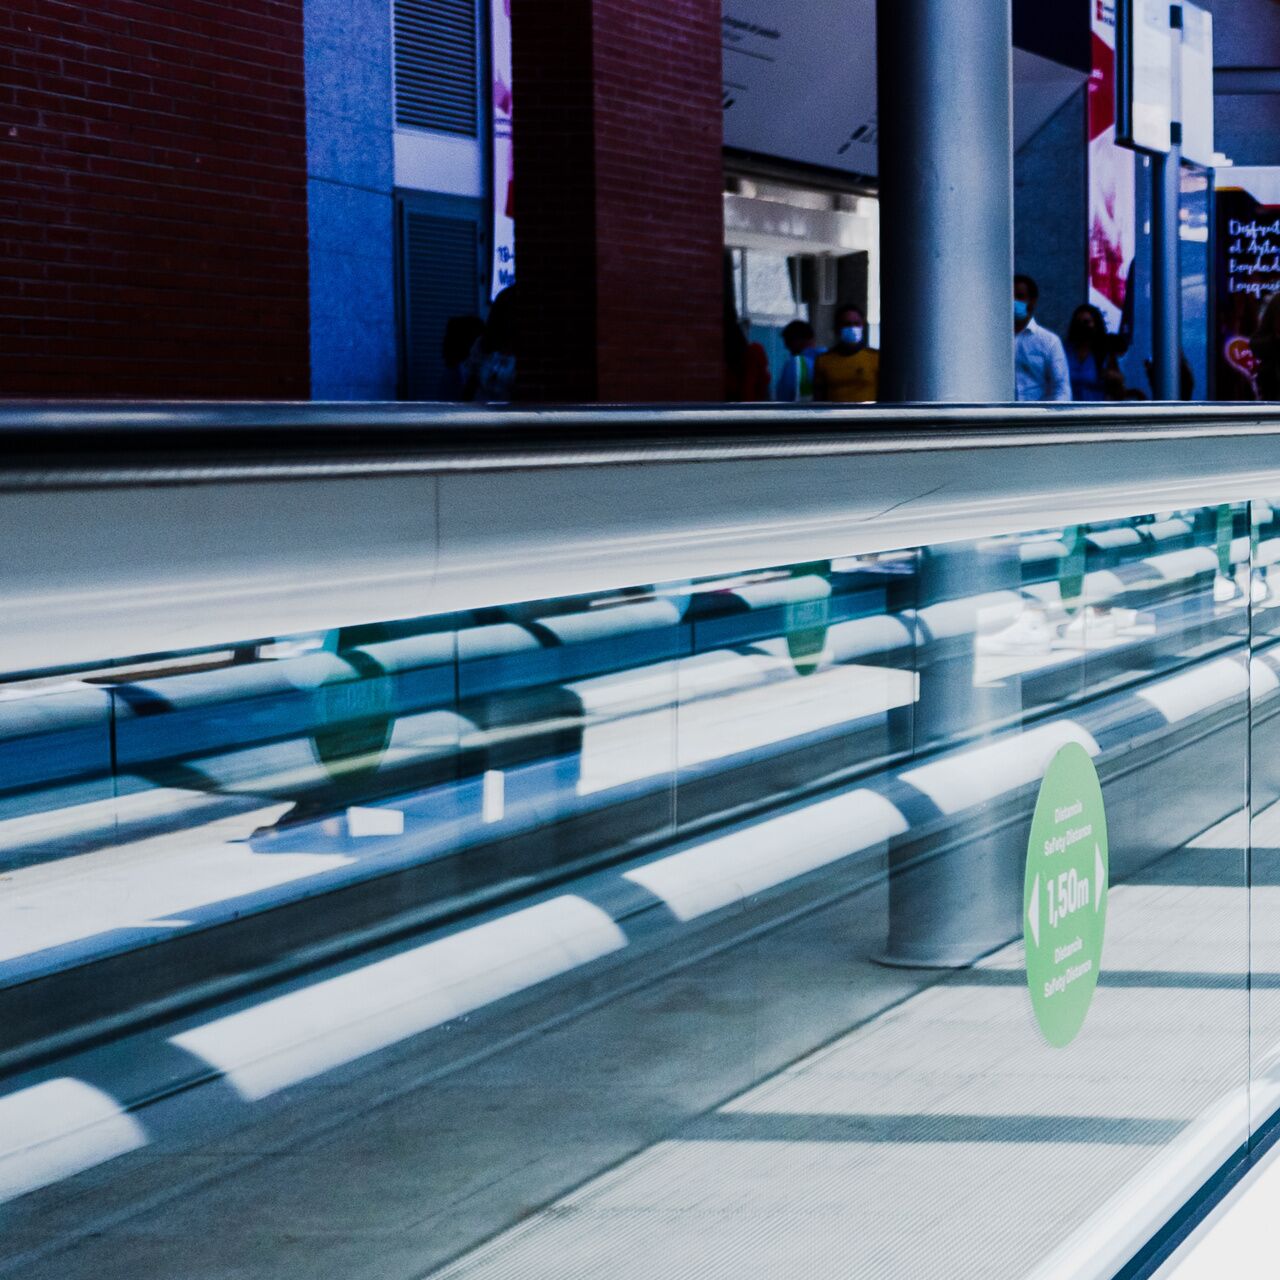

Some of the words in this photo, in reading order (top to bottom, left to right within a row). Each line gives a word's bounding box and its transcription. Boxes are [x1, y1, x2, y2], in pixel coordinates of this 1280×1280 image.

[1044, 836, 1066, 856] Safety
[1066, 823, 1092, 846] Distance
[1046, 867, 1090, 928] 1,50m
[1044, 975, 1066, 998] Safety
[1066, 959, 1092, 985] Distance
